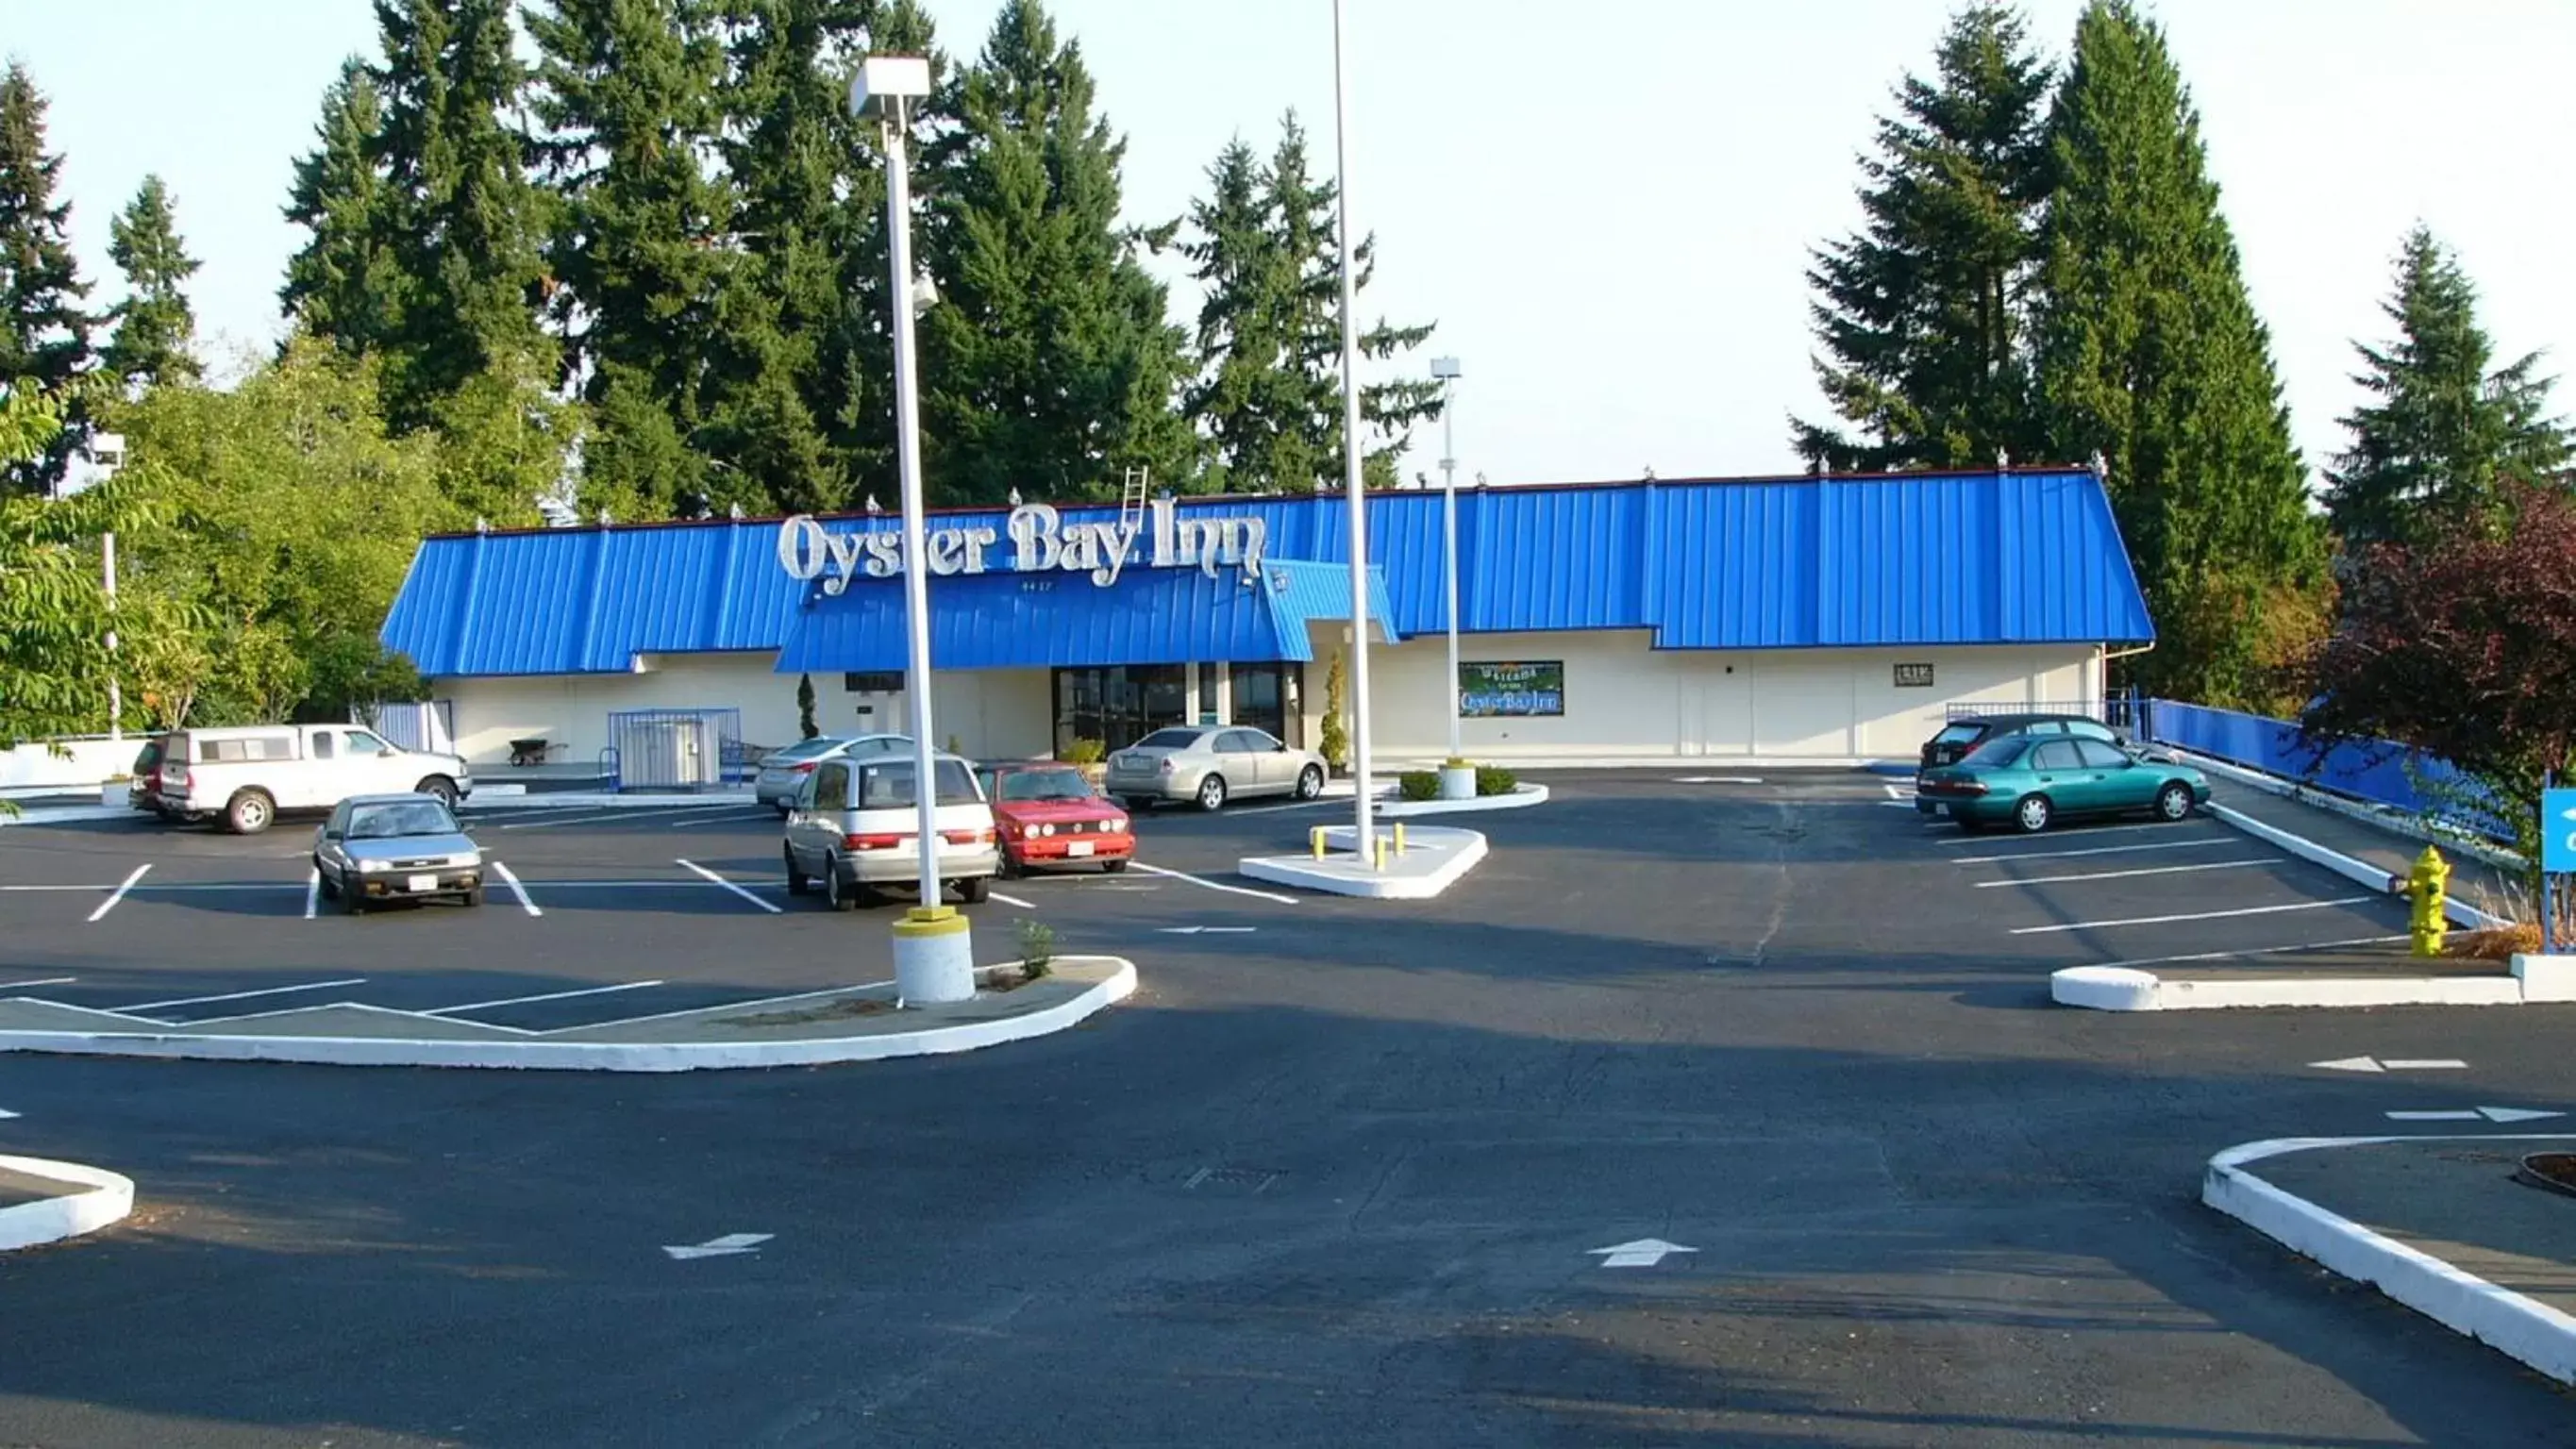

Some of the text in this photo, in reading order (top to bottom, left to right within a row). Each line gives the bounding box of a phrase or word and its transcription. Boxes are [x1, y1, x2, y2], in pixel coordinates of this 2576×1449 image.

[778, 496, 1265, 595] Oyser Bay Inn
